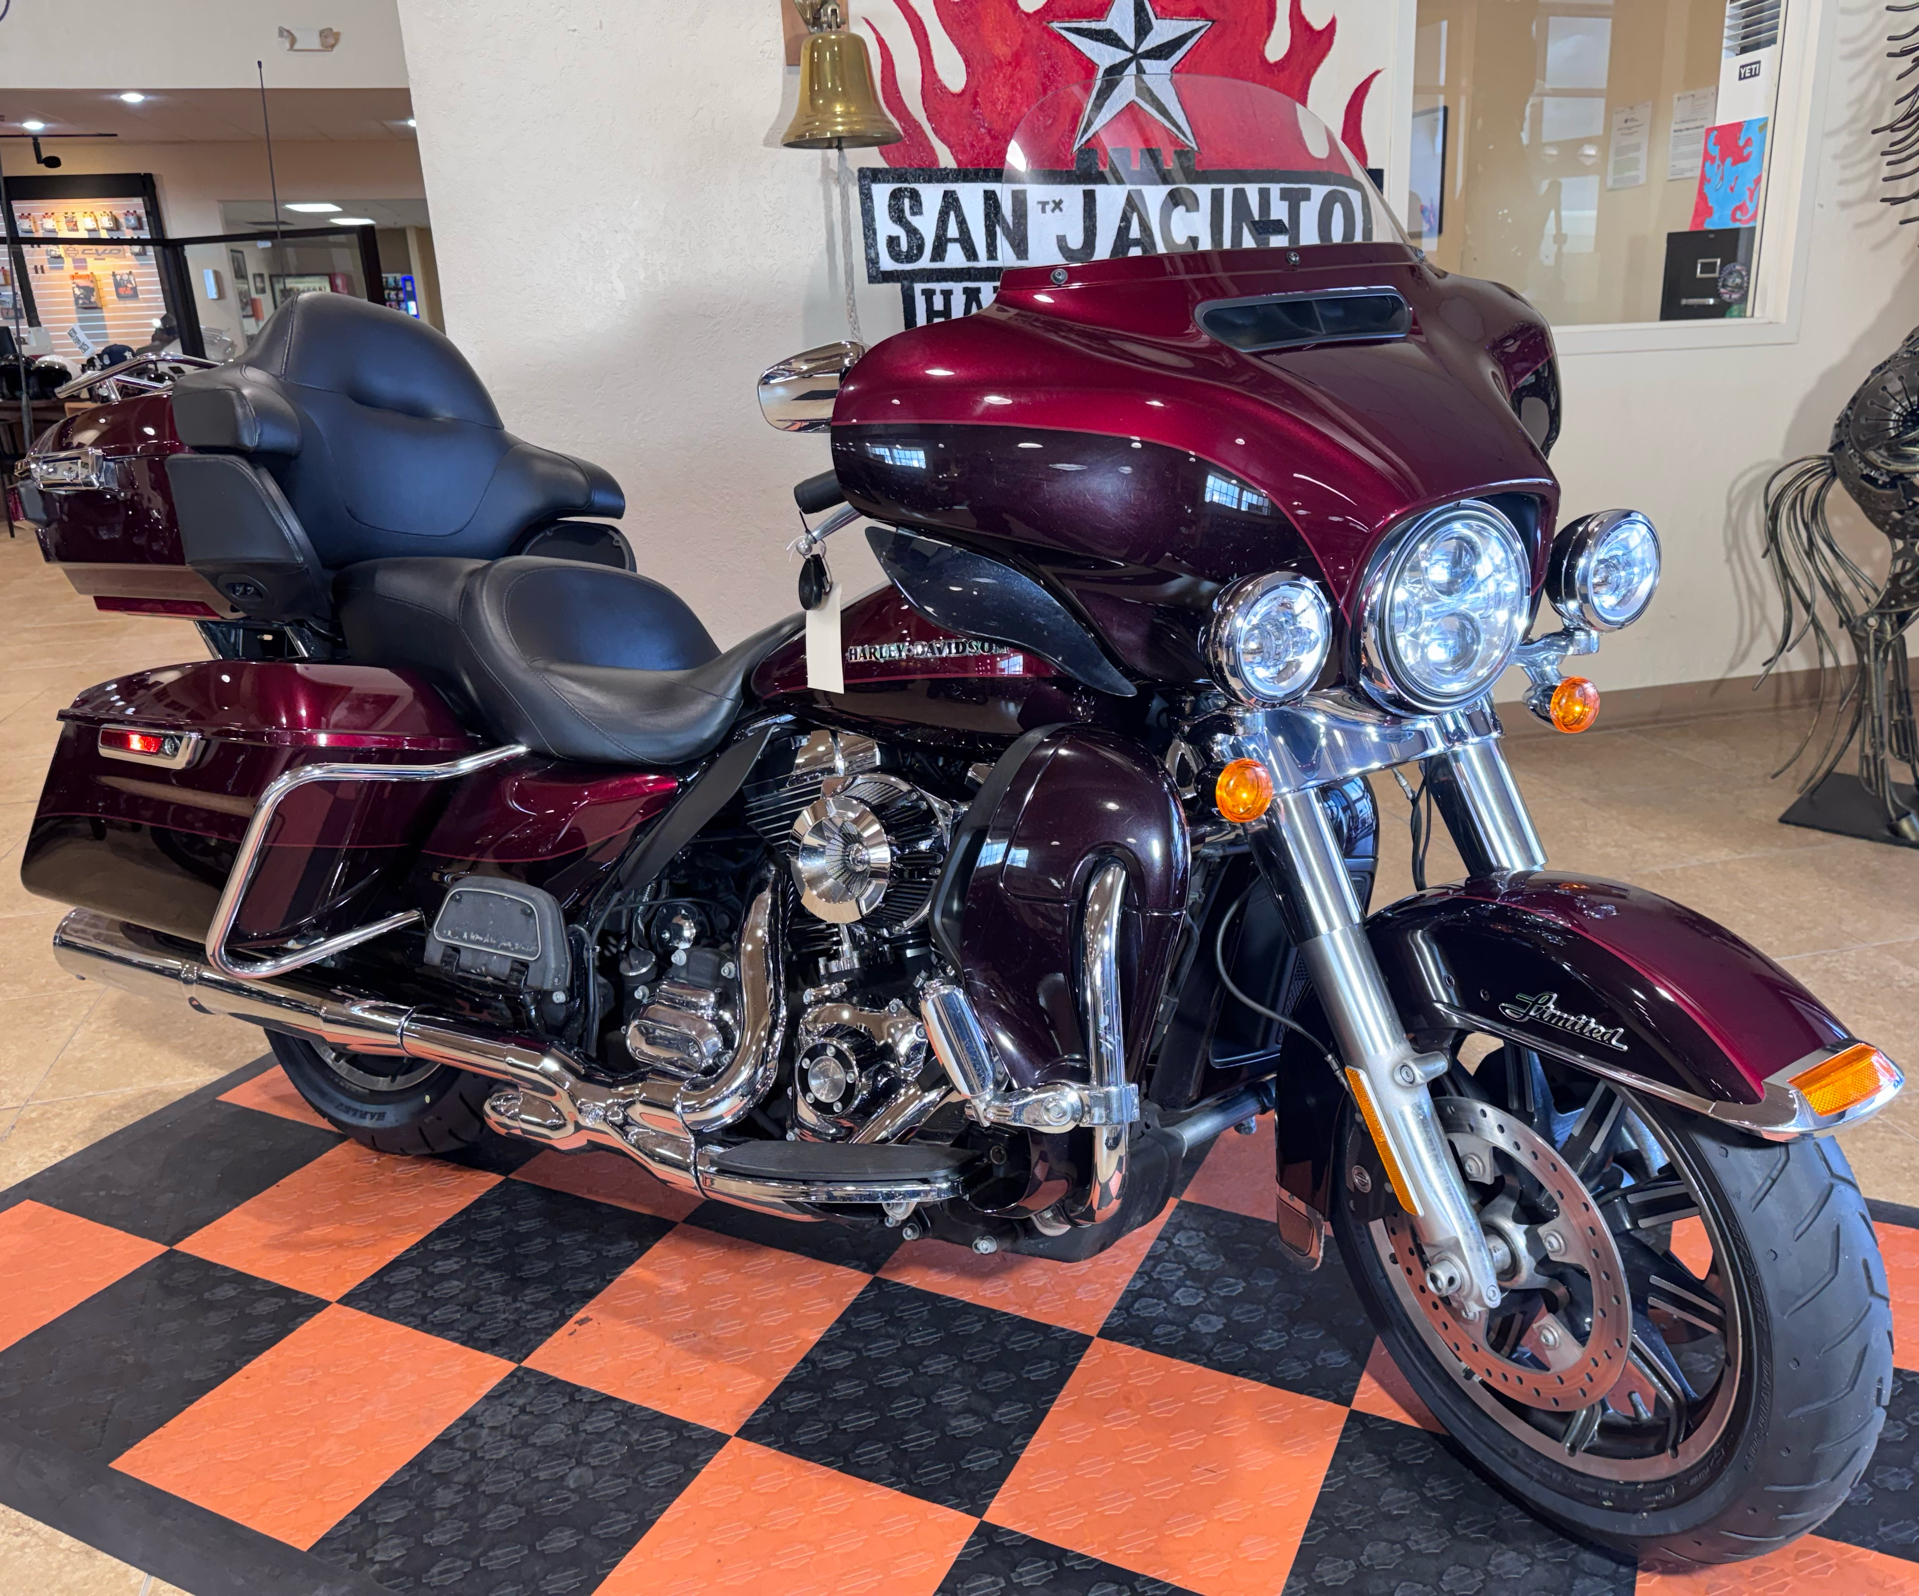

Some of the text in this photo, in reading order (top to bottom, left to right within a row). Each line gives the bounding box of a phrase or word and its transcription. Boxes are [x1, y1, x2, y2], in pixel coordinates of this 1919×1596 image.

[1740, 63, 1760, 79] YETI
[886, 187, 1356, 264] SAN TX JACINTO
[81, 248, 121, 257] CVO
[921, 286, 1000, 325] HA
[1499, 991, 1628, 1051] Limited
